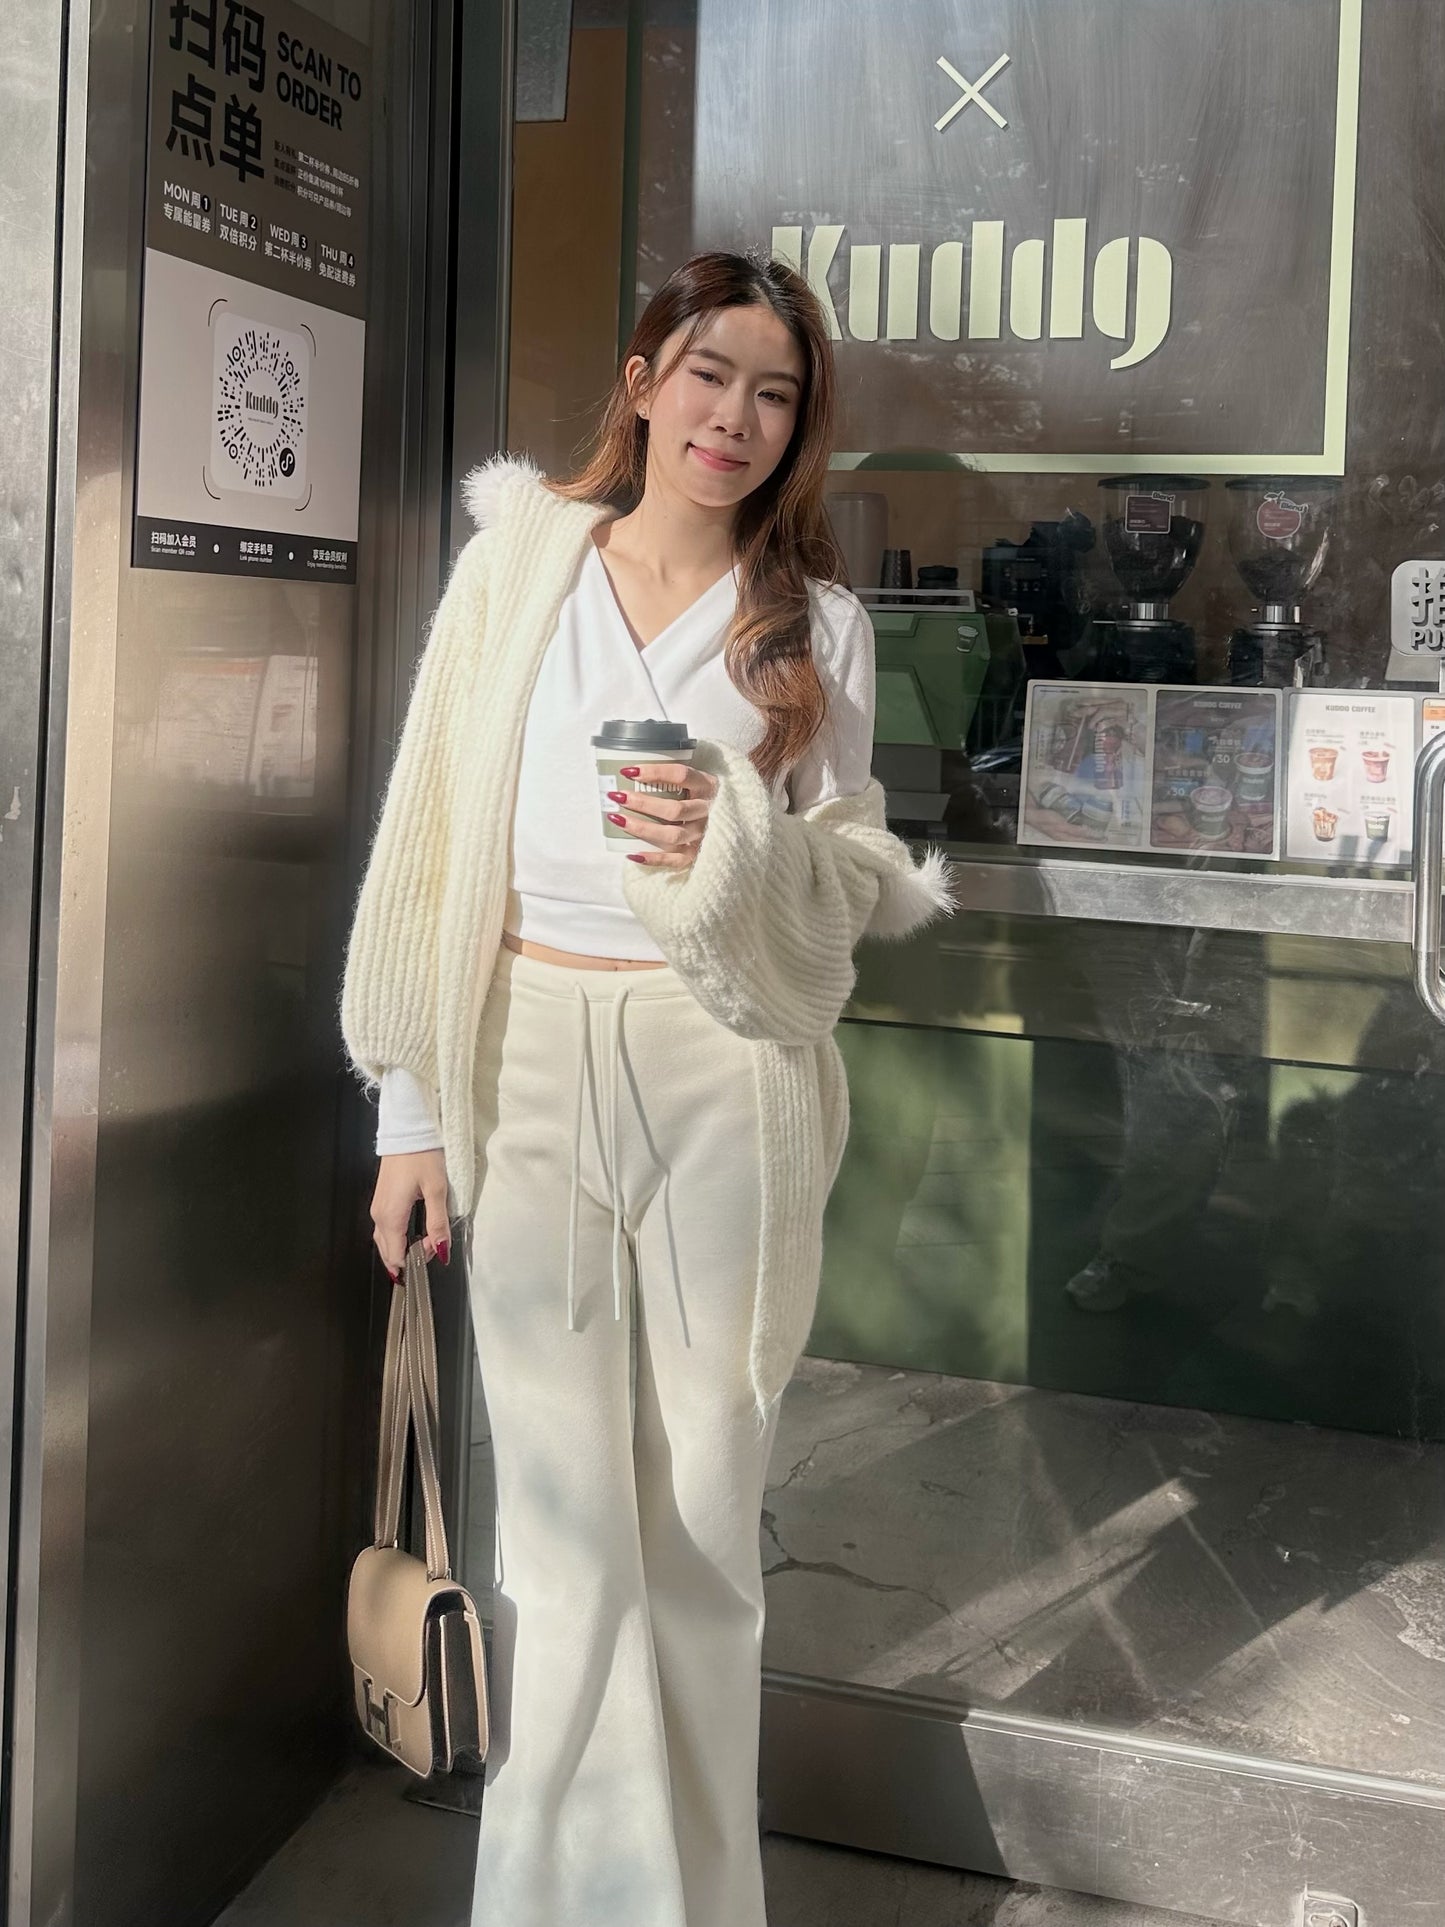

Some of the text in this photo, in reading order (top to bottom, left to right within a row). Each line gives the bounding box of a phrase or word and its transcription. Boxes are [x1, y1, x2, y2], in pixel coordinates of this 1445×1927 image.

[170, 0, 266, 93] 扫码
[277, 31, 362, 101] SCAN TO
[276, 71, 343, 131] ORDER
[166, 73, 264, 183] 点单
[163, 181, 190, 204] MON
[163, 202, 211, 234] 专属能量券
[220, 203, 238, 224] TUE
[219, 224, 257, 251] 双倍积分
[270, 223, 290, 243] WED
[264, 241, 312, 271] 第二杯半价券
[320, 244, 338, 261] THU
[151, 532, 197, 549] 扫码加入会员
[240, 541, 273, 556] 绑定手机号
